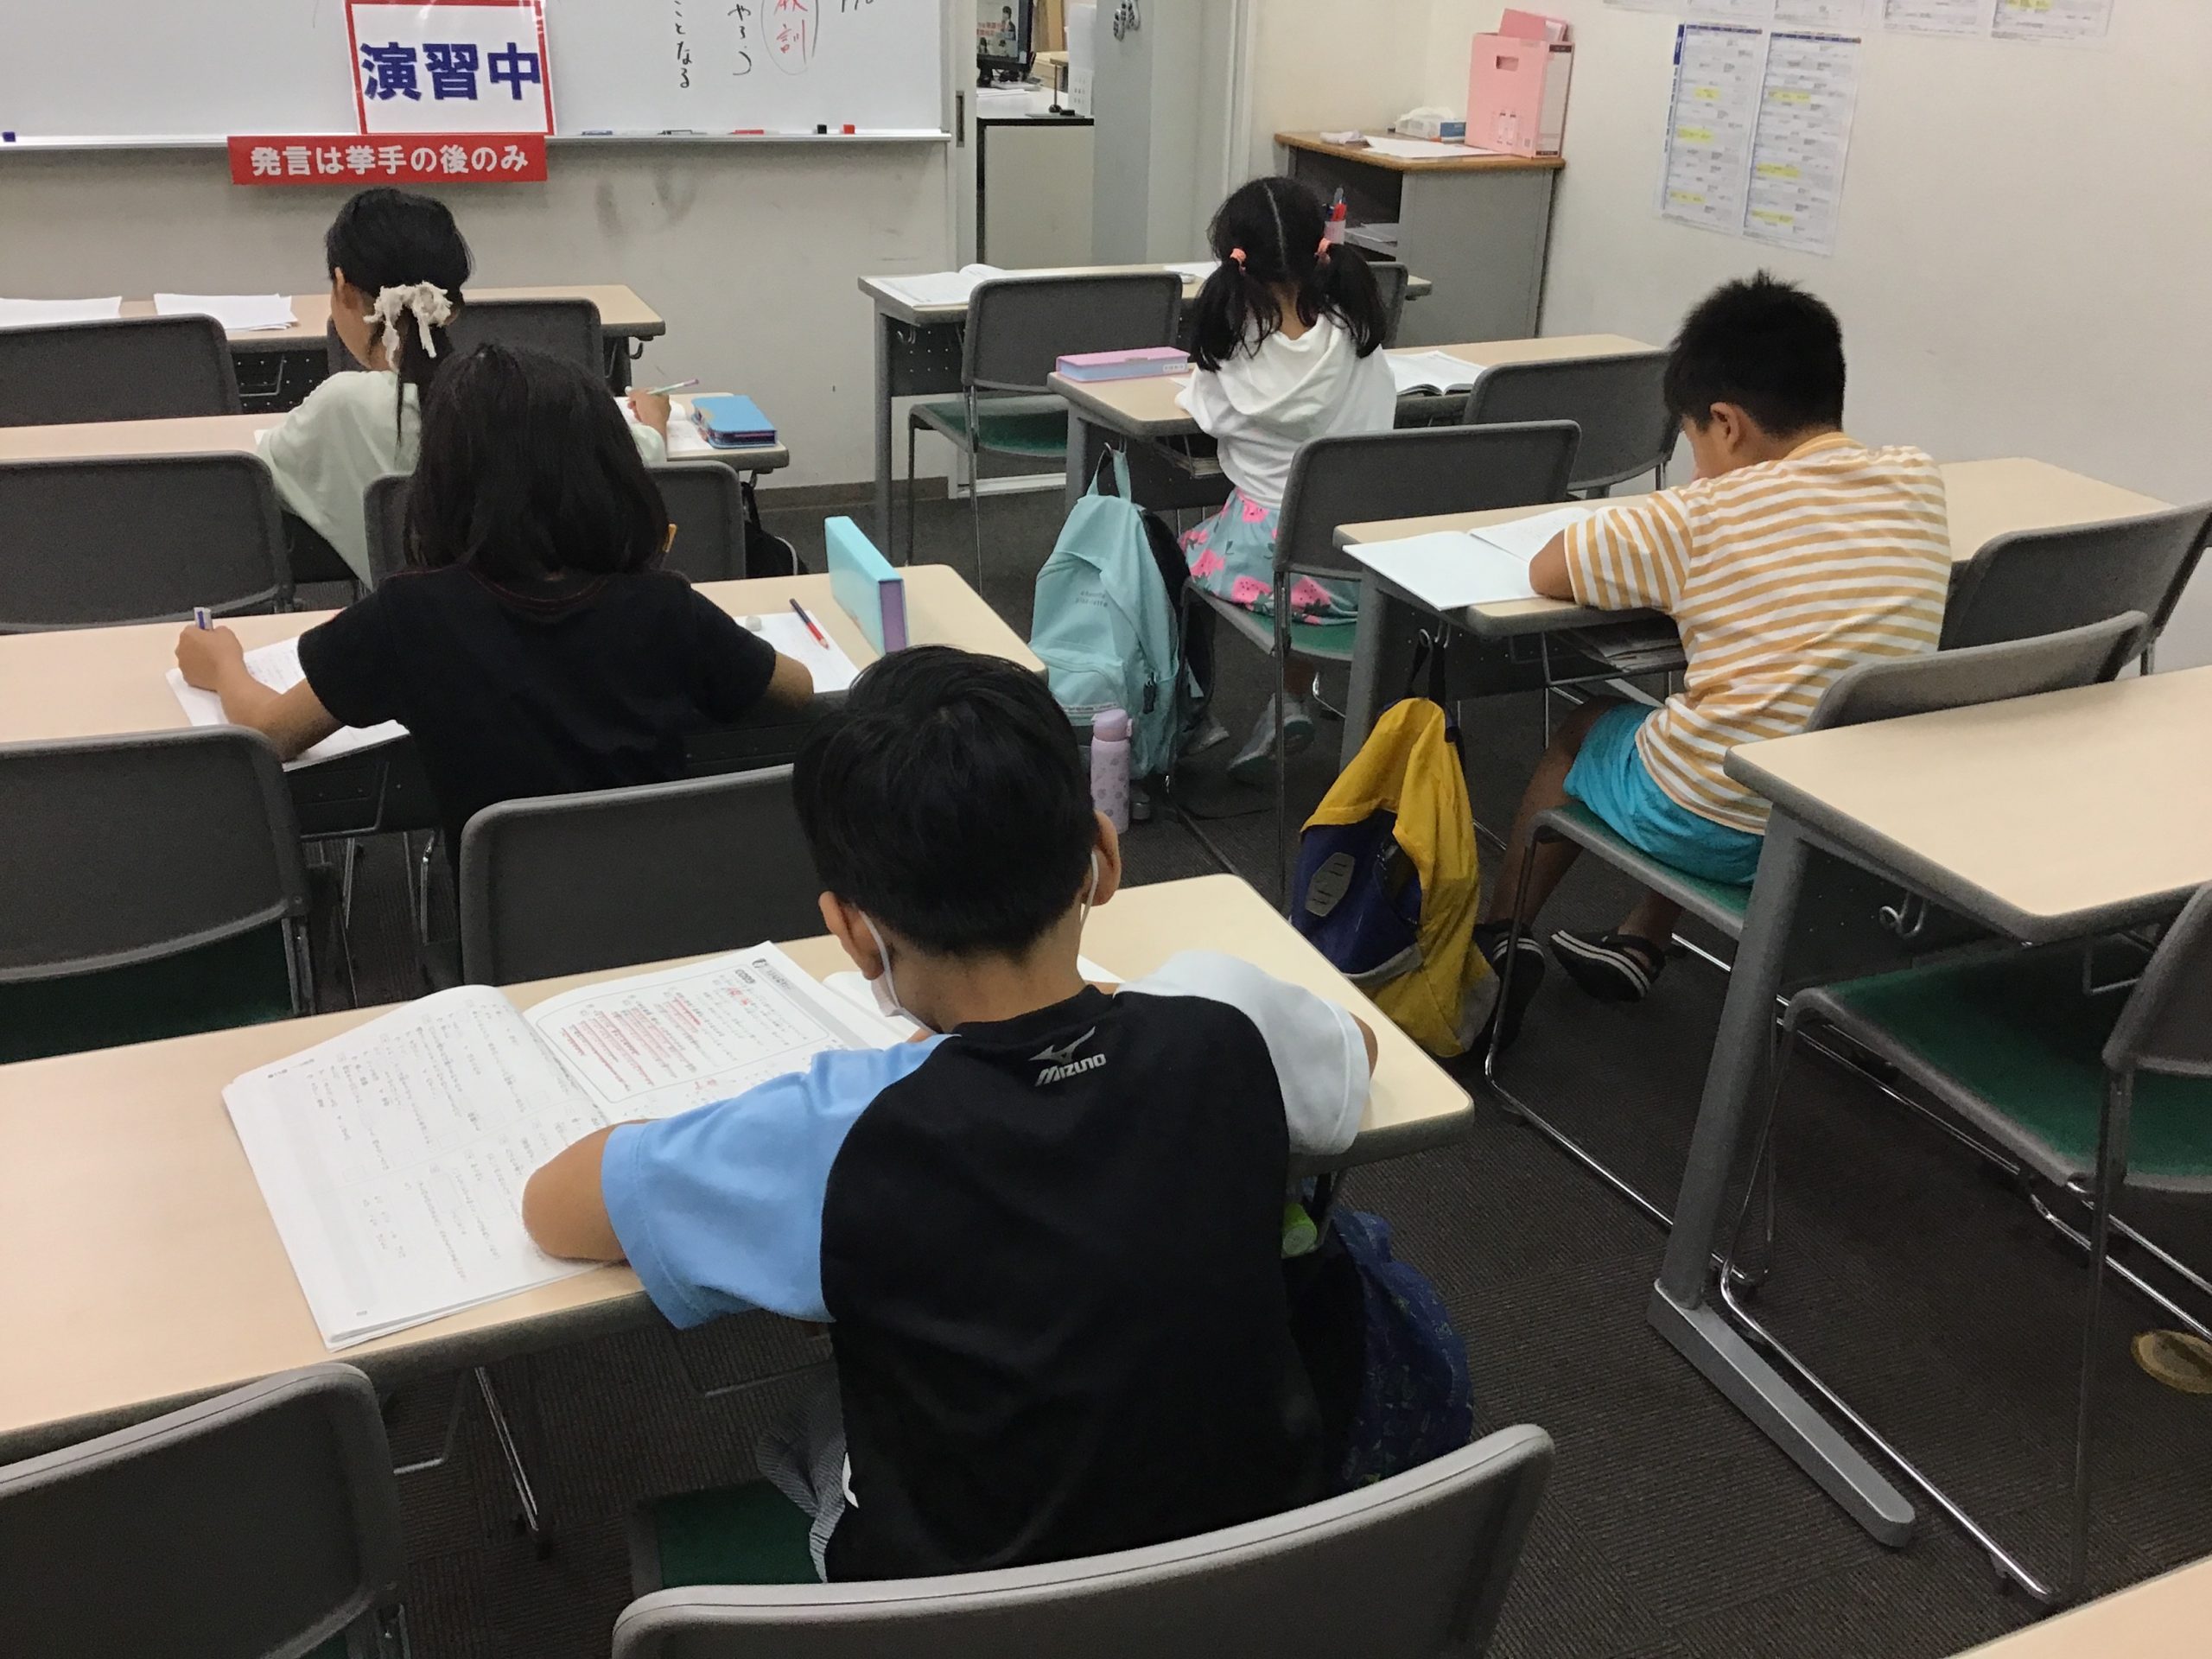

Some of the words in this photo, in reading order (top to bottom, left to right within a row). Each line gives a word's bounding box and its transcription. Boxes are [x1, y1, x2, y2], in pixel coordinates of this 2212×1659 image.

[359, 41, 541, 101] 演習中
[251, 144, 529, 176] 発言は挙手の後のみ
